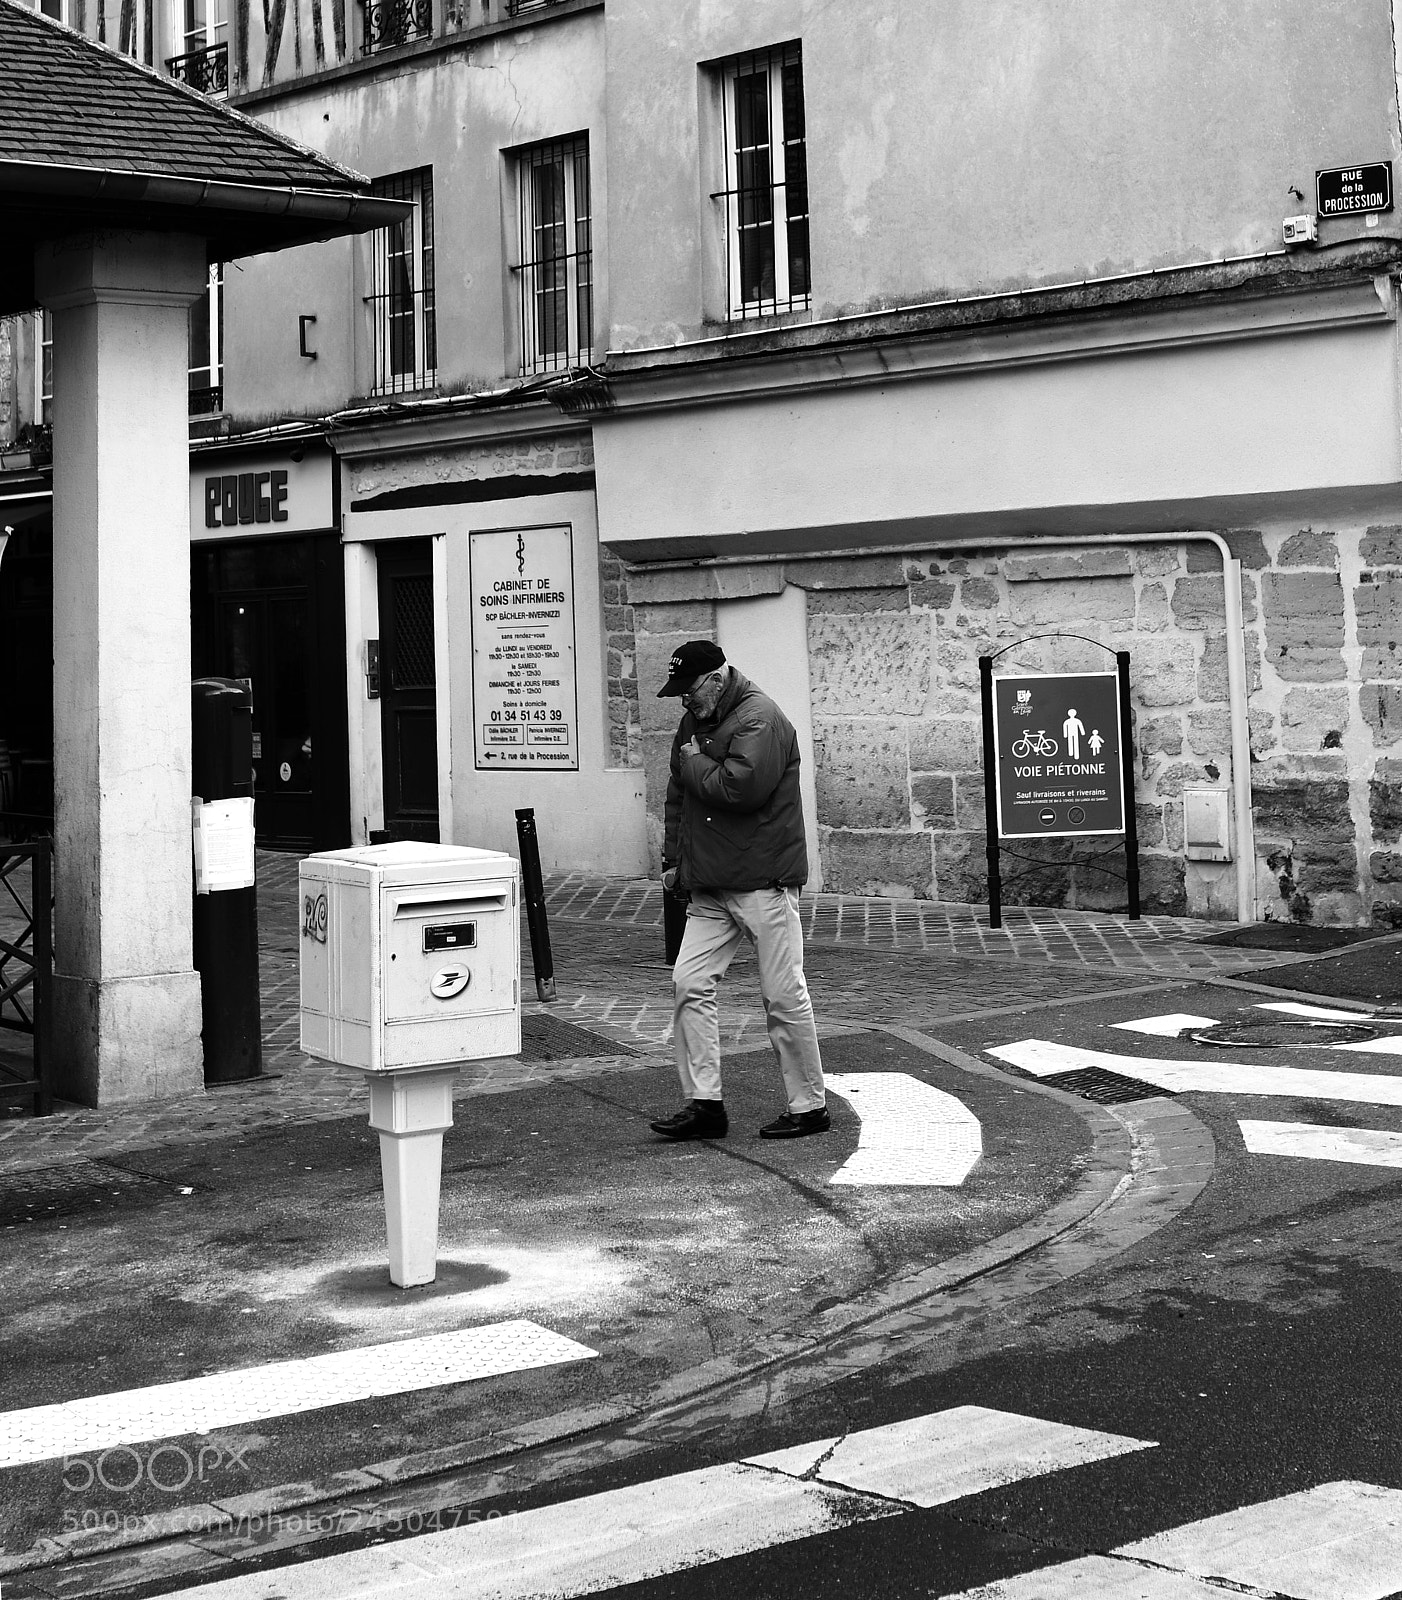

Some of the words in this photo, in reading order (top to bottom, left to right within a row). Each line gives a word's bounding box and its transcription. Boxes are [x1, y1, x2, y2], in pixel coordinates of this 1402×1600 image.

[1341, 170, 1362, 181] RUE
[1342, 185, 1353, 193] de
[1355, 183, 1363, 191] la
[1325, 192, 1383, 213] PROCESSION
[493, 580, 533, 592] CABINET
[537, 579, 550, 589] DE
[480, 595, 508, 607] SOINS
[513, 592, 565, 604] INFIRMIERS
[486, 613, 497, 621] SCP
[491, 711, 501, 721] 01
[505, 711, 516, 721] 34
[520, 710, 530, 721] 51
[534, 710, 546, 720] 43
[550, 710, 562, 720] 39
[520, 752, 527, 760] de
[529, 752, 534, 760] la
[537, 752, 569, 760] Procession
[1014, 766, 1042, 777] VOIE
[1047, 762, 1105, 776] PIÉTONNE
